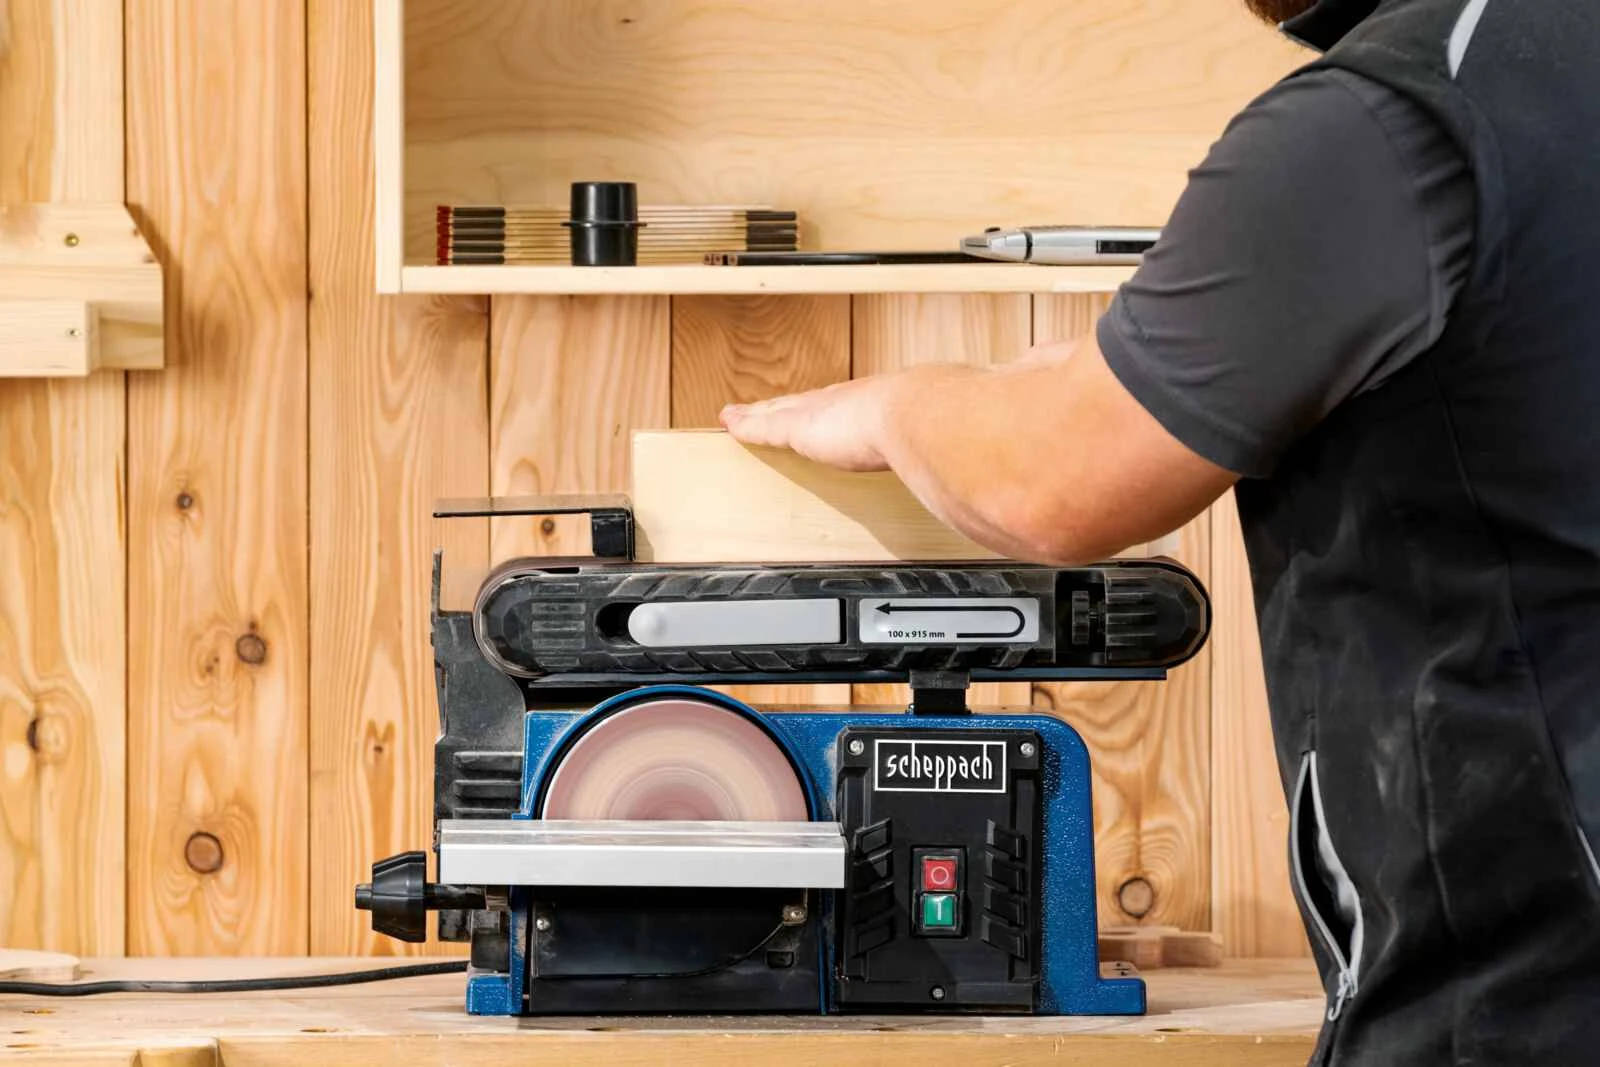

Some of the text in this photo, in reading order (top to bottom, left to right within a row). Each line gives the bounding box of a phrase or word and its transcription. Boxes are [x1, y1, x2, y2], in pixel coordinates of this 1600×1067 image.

[888, 630, 903, 638] 100
[911, 630, 927, 638] 915
[886, 743, 993, 789] scheppach
